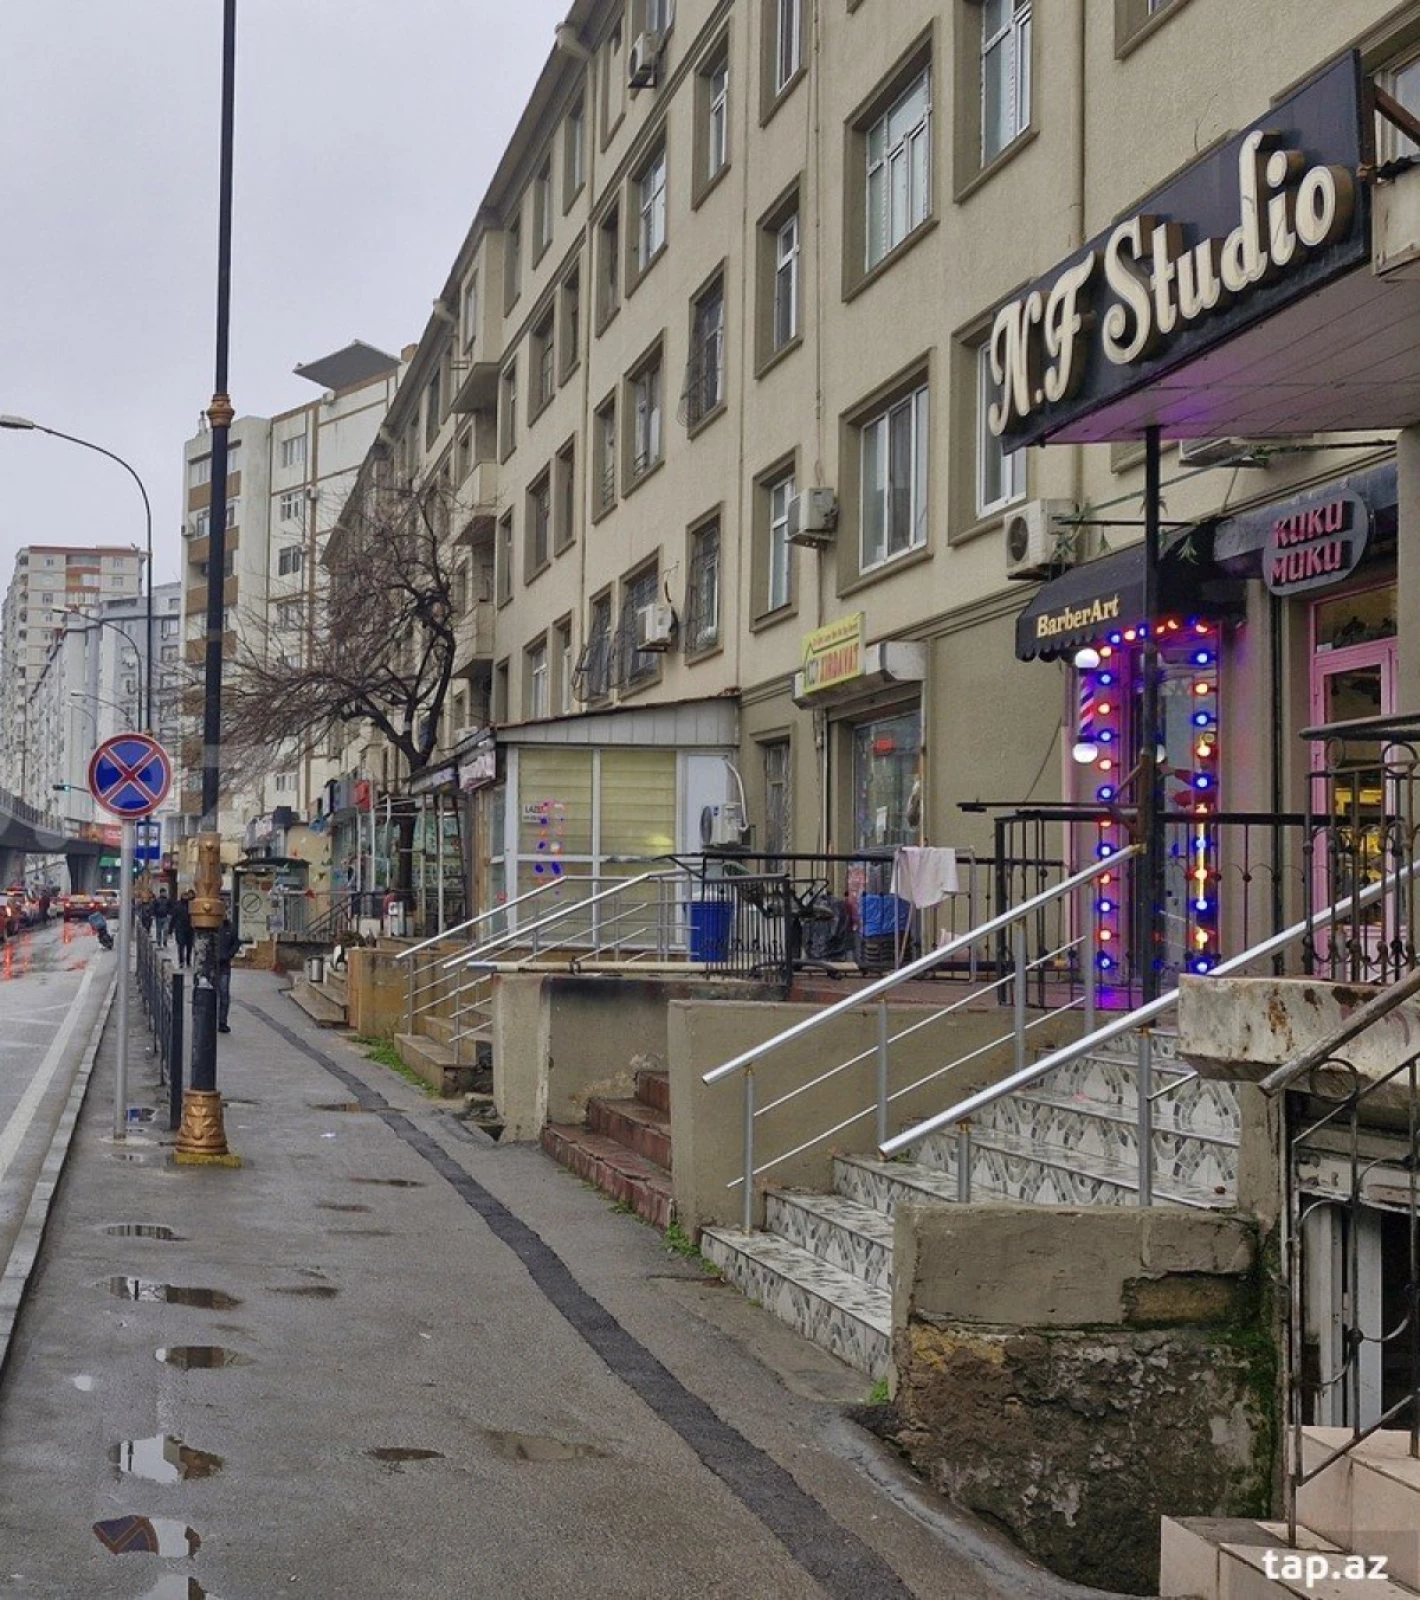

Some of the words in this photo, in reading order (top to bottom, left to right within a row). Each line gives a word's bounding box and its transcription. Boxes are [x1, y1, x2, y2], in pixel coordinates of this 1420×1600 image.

[1102, 130, 1338, 365] Studio
[1271, 500, 1344, 549] KUKU
[1271, 540, 1343, 586] MUKU
[1036, 593, 1120, 638] BarberArt
